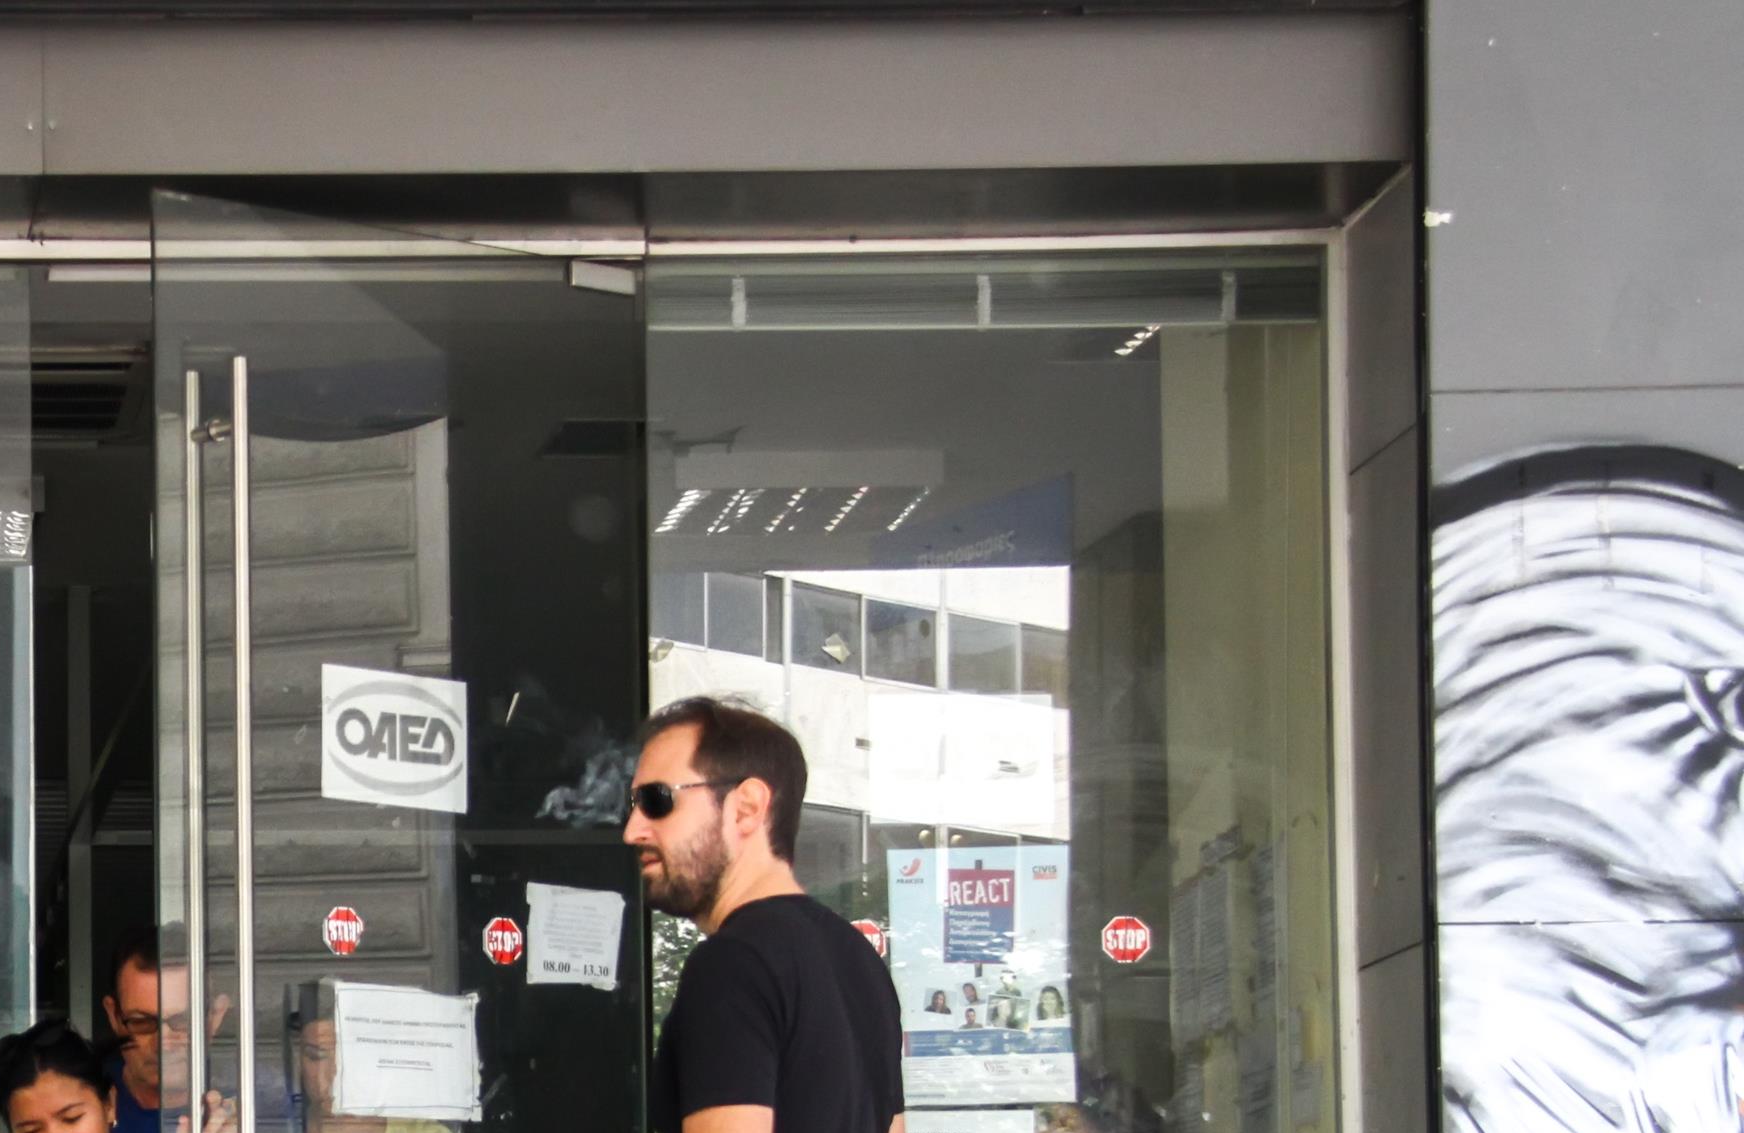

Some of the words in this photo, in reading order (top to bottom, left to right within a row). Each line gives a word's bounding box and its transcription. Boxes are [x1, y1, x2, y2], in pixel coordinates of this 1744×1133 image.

[335, 707, 455, 767] ΟΑΕΔ
[1106, 928, 1147, 950] STOP
[543, 960, 571, 973] 08.00
[583, 964, 609, 977] 13.30
